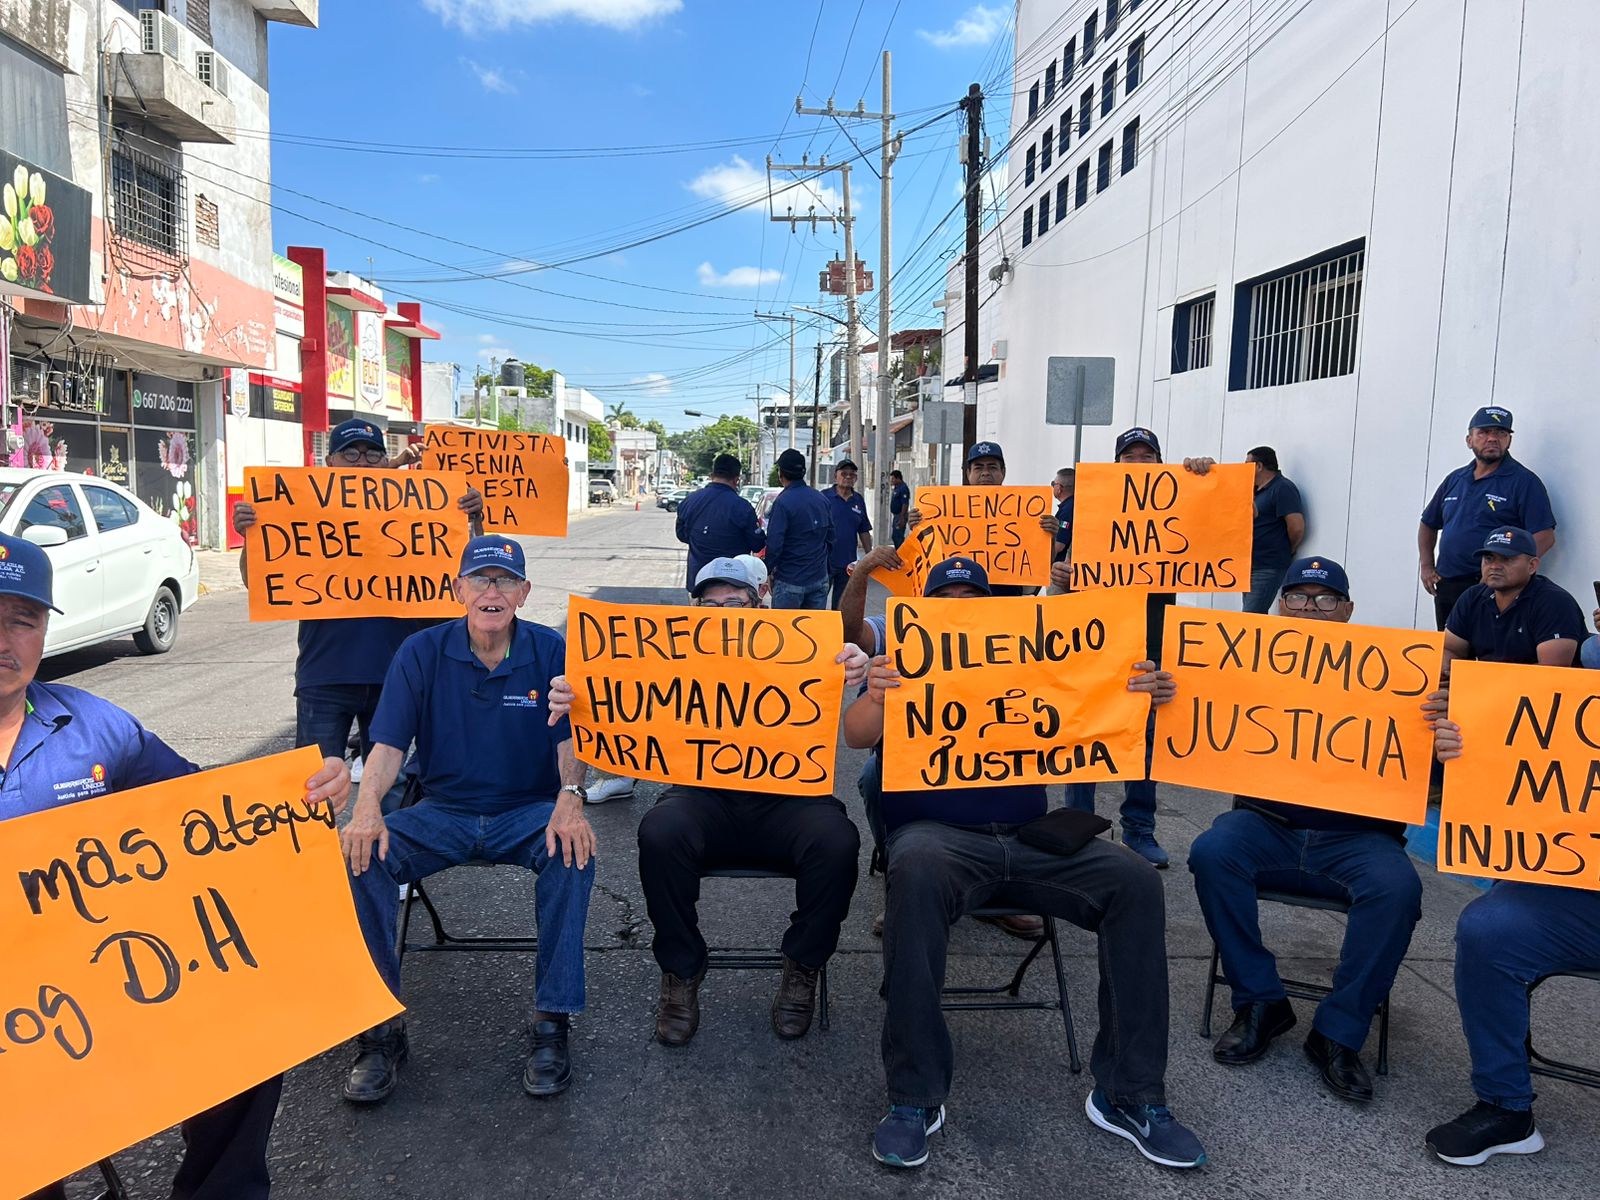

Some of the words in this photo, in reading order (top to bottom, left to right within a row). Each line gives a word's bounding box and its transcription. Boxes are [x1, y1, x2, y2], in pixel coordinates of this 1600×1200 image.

[142, 392, 158, 409] 667
[159, 394, 175, 412] 206
[177, 396, 193, 413] 2221
[426, 430, 556, 454] ACTIVISTA
[251, 474, 295, 506] LA
[308, 472, 449, 512] VERDAD
[484, 478, 538, 499] ESTA
[919, 493, 1046, 519] SILENCIO
[1122, 471, 1178, 513] NO
[261, 521, 363, 562] DEBE
[381, 519, 453, 558] SER
[937, 523, 971, 546] NO
[986, 522, 1021, 547] ES
[1110, 517, 1189, 556] MAS
[266, 573, 456, 605] ESCUCHADA
[1073, 558, 1237, 588] INJUSTICIAS
[579, 611, 818, 665] DERECHOS
[893, 602, 1105, 679] SILENCIO
[1177, 621, 1435, 697] EXIGIMOS
[586, 676, 822, 730] HUMANOS
[906, 683, 967, 738] NO
[574, 724, 670, 776] PARA
[685, 739, 828, 784] TODOS
[1167, 696, 1408, 781] JUSTICIA
[920, 735, 1119, 787] JUSTICIA
